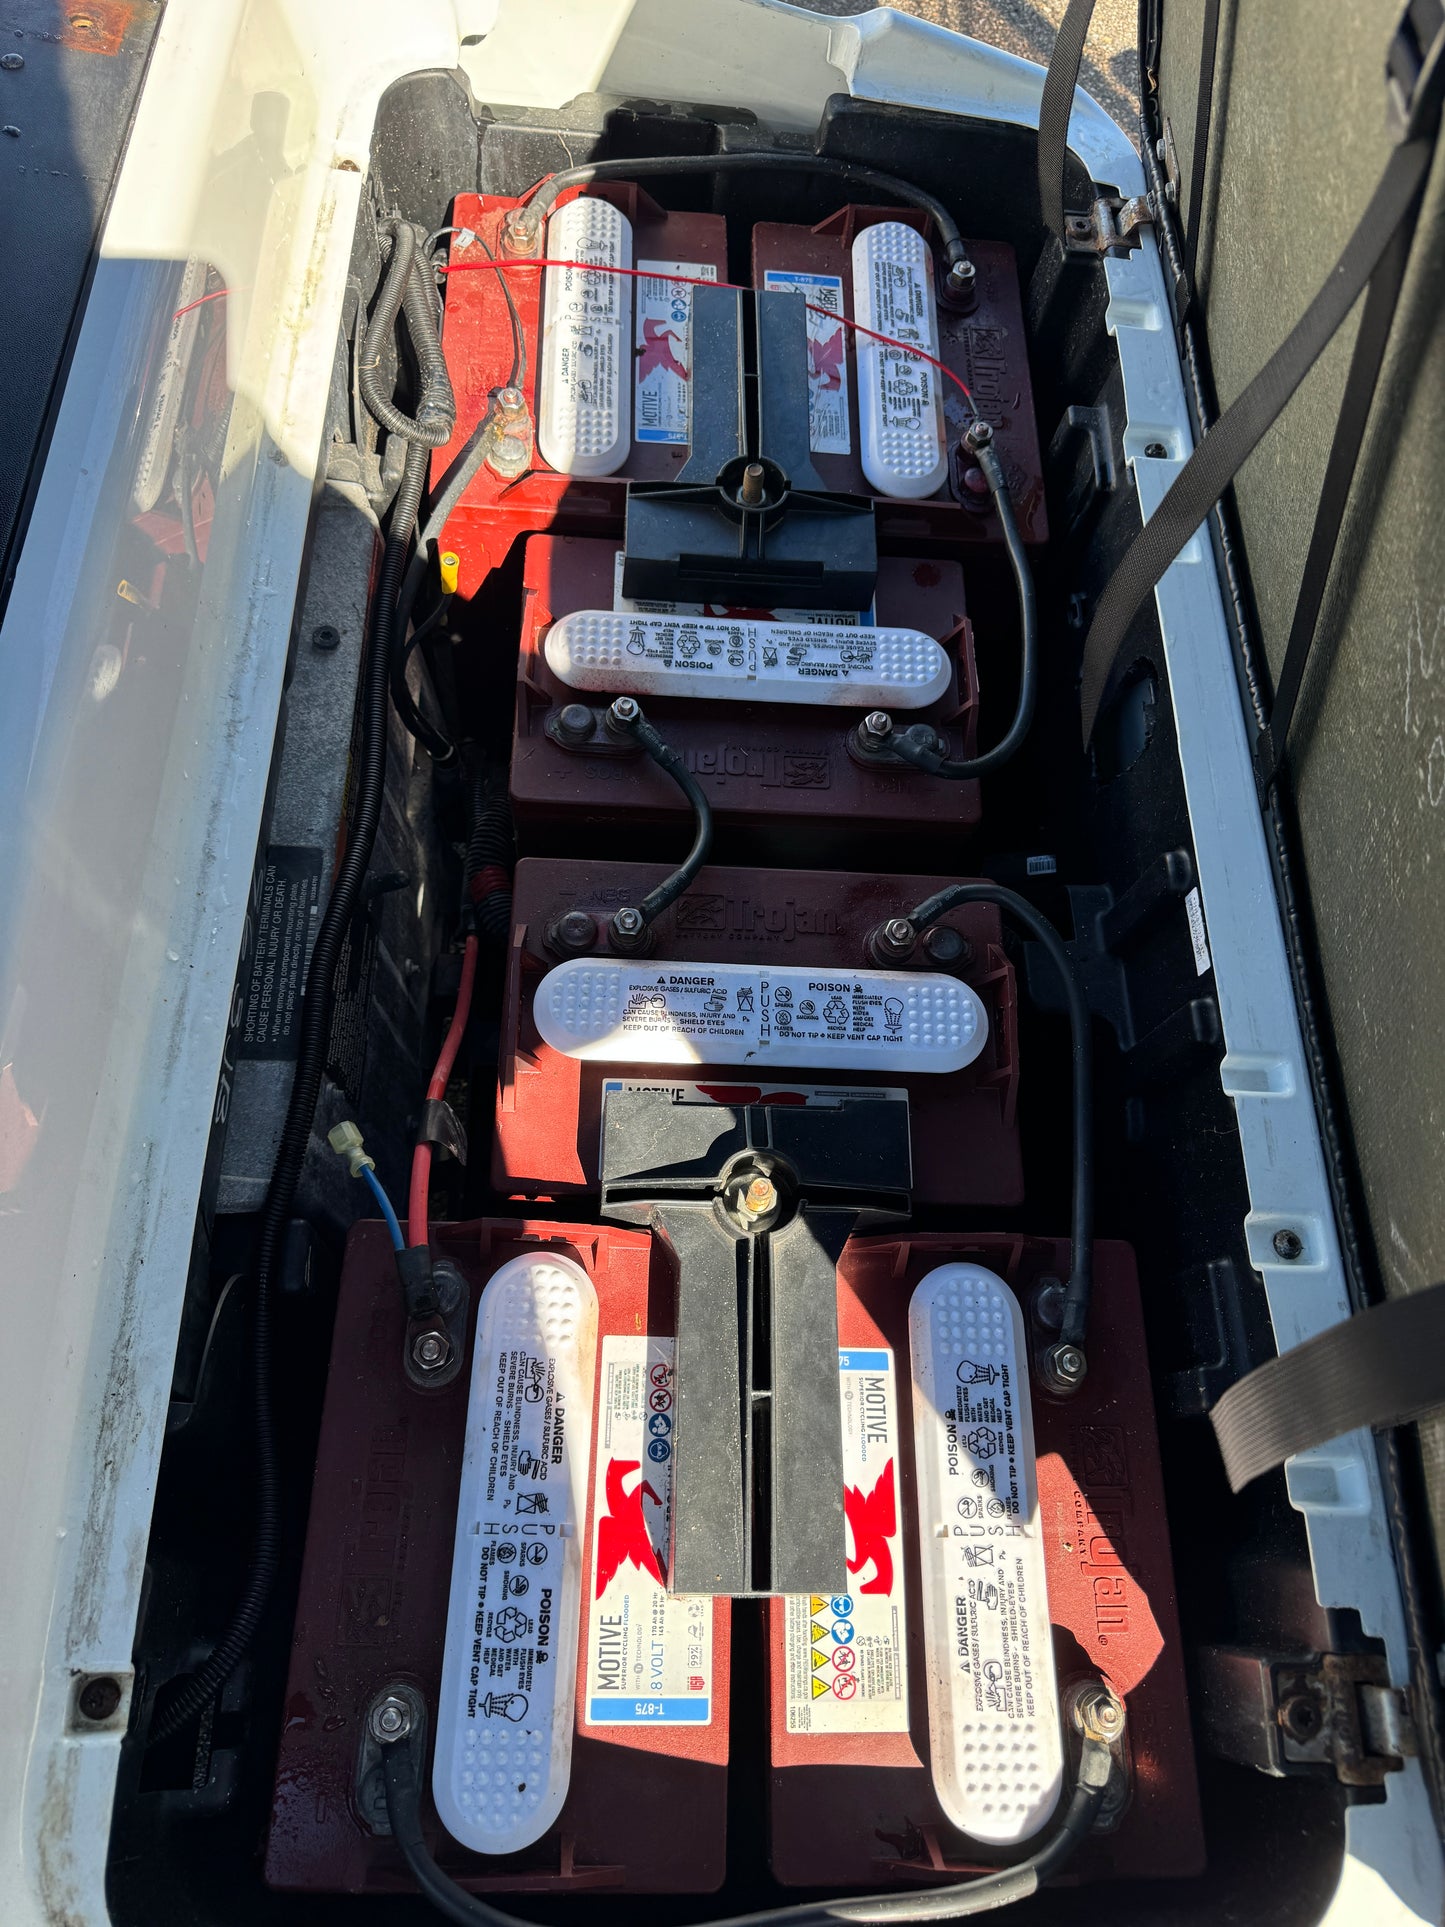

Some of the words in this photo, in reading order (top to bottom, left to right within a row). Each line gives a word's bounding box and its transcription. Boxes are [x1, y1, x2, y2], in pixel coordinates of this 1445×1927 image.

[915, 290, 923, 317] DANGER
[562, 348, 570, 376] DANGER
[920, 372, 929, 398] POISON
[642, 391, 657, 426] MOTIVE
[675, 659, 713, 669] POISON
[798, 667, 838, 677] DANGER
[264, 865, 276, 883] CAN
[274, 878, 287, 908] DEATH.
[258, 886, 274, 934] TERMINALS
[272, 911, 283, 923] OR
[284, 903, 297, 934] mounting
[293, 932, 302, 941] on
[295, 919, 304, 930] top
[268, 926, 281, 957] INJURY
[253, 937, 268, 976] BATTERY
[279, 936, 293, 976] component
[290, 944, 301, 968] directly
[251, 979, 262, 991] OF
[261, 960, 277, 1008] PERSONAL
[288, 970, 298, 988] plate
[670, 977, 714, 986] DANGER
[809, 983, 850, 992] POISON
[275, 978, 288, 1011] removing
[285, 990, 295, 1009] place
[244, 994, 260, 1042] SHORTING
[257, 1012, 270, 1042] CAUSE
[272, 1014, 284, 1035] When
[283, 1012, 293, 1023] not
[282, 1026, 291, 1035] do
[498, 1353, 507, 1373] KEEP
[508, 1351, 517, 1380] SEVERE
[496, 1377, 505, 1394] OUT
[516, 1369, 525, 1394] CAUSE
[546, 1359, 555, 1394] EXPLOSIVE
[1001, 1364, 1010, 1387] TIGHT
[495, 1396, 503, 1408] OF
[506, 1383, 515, 1408] BURNS
[1003, 1391, 1011, 1407] CAP
[512, 1397, 522, 1443] BLINDNESS,
[544, 1396, 552, 1420] GASES
[865, 1377, 887, 1443] MOTIVE
[492, 1411, 502, 1439] REACH
[1004, 1410, 1013, 1431] VENT
[491, 1442, 499, 1453] OF
[502, 1420, 511, 1451] SHIELD
[541, 1426, 550, 1459] SULFURIC
[552, 1408, 565, 1464] DANGER
[1006, 1434, 1015, 1455] KEEP
[510, 1445, 519, 1472] INJURY
[947, 1425, 959, 1475] POISON
[500, 1454, 509, 1477] EYES
[540, 1461, 548, 1480] ACID
[1009, 1465, 1017, 1477] TIP
[487, 1457, 498, 1500] CHILDREN
[508, 1474, 516, 1490] AND
[1010, 1481, 1018, 1498] NOT
[1012, 1501, 1020, 1513] DO
[1074, 1491, 1087, 1556] COMPANY
[480, 1547, 489, 1560] DO
[479, 1563, 488, 1581] NOT
[1015, 1558, 1025, 1603] CHILDREN
[477, 1586, 486, 1599] TIP
[474, 1611, 484, 1635] KEEP
[538, 1589, 552, 1646] POISON
[1019, 1606, 1027, 1618] OF
[956, 1597, 969, 1656] DANGER
[1020, 1621, 1029, 1652] REACH
[472, 1638, 482, 1663] VENT
[489, 1648, 497, 1677] MEDICAL
[598, 1615, 622, 1689] MOTIVE
[651, 1641, 663, 1677] VOLT
[1022, 1655, 1030, 1668] OF
[470, 1667, 480, 1686] CAP
[525, 1648, 534, 1692] IMMEDIATELY
[1023, 1671, 1032, 1690] OUT
[651, 1682, 663, 1690] 8
[690, 1676, 704, 1690] USA
[467, 1690, 478, 1718] TIGHT
[635, 1703, 664, 1715] T-875
[1025, 1693, 1034, 1717] KEEP
